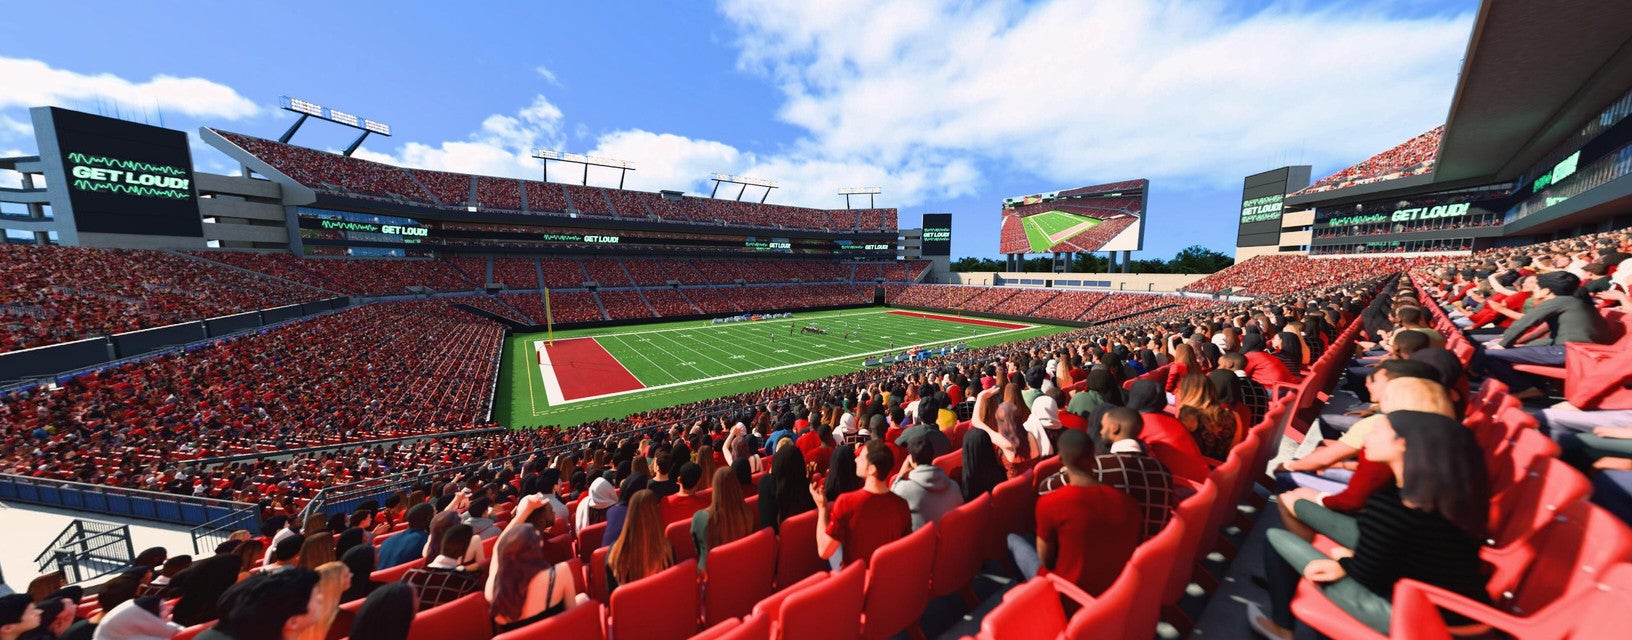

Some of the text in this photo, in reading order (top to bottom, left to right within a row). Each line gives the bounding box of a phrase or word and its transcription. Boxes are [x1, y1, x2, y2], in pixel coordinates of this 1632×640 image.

[73, 166, 189, 190] GET LOUD!
[1242, 202, 1283, 216] GET LOUD!
[1392, 202, 1470, 222] GET LOUD!
[382, 225, 428, 236] GET LOUD!
